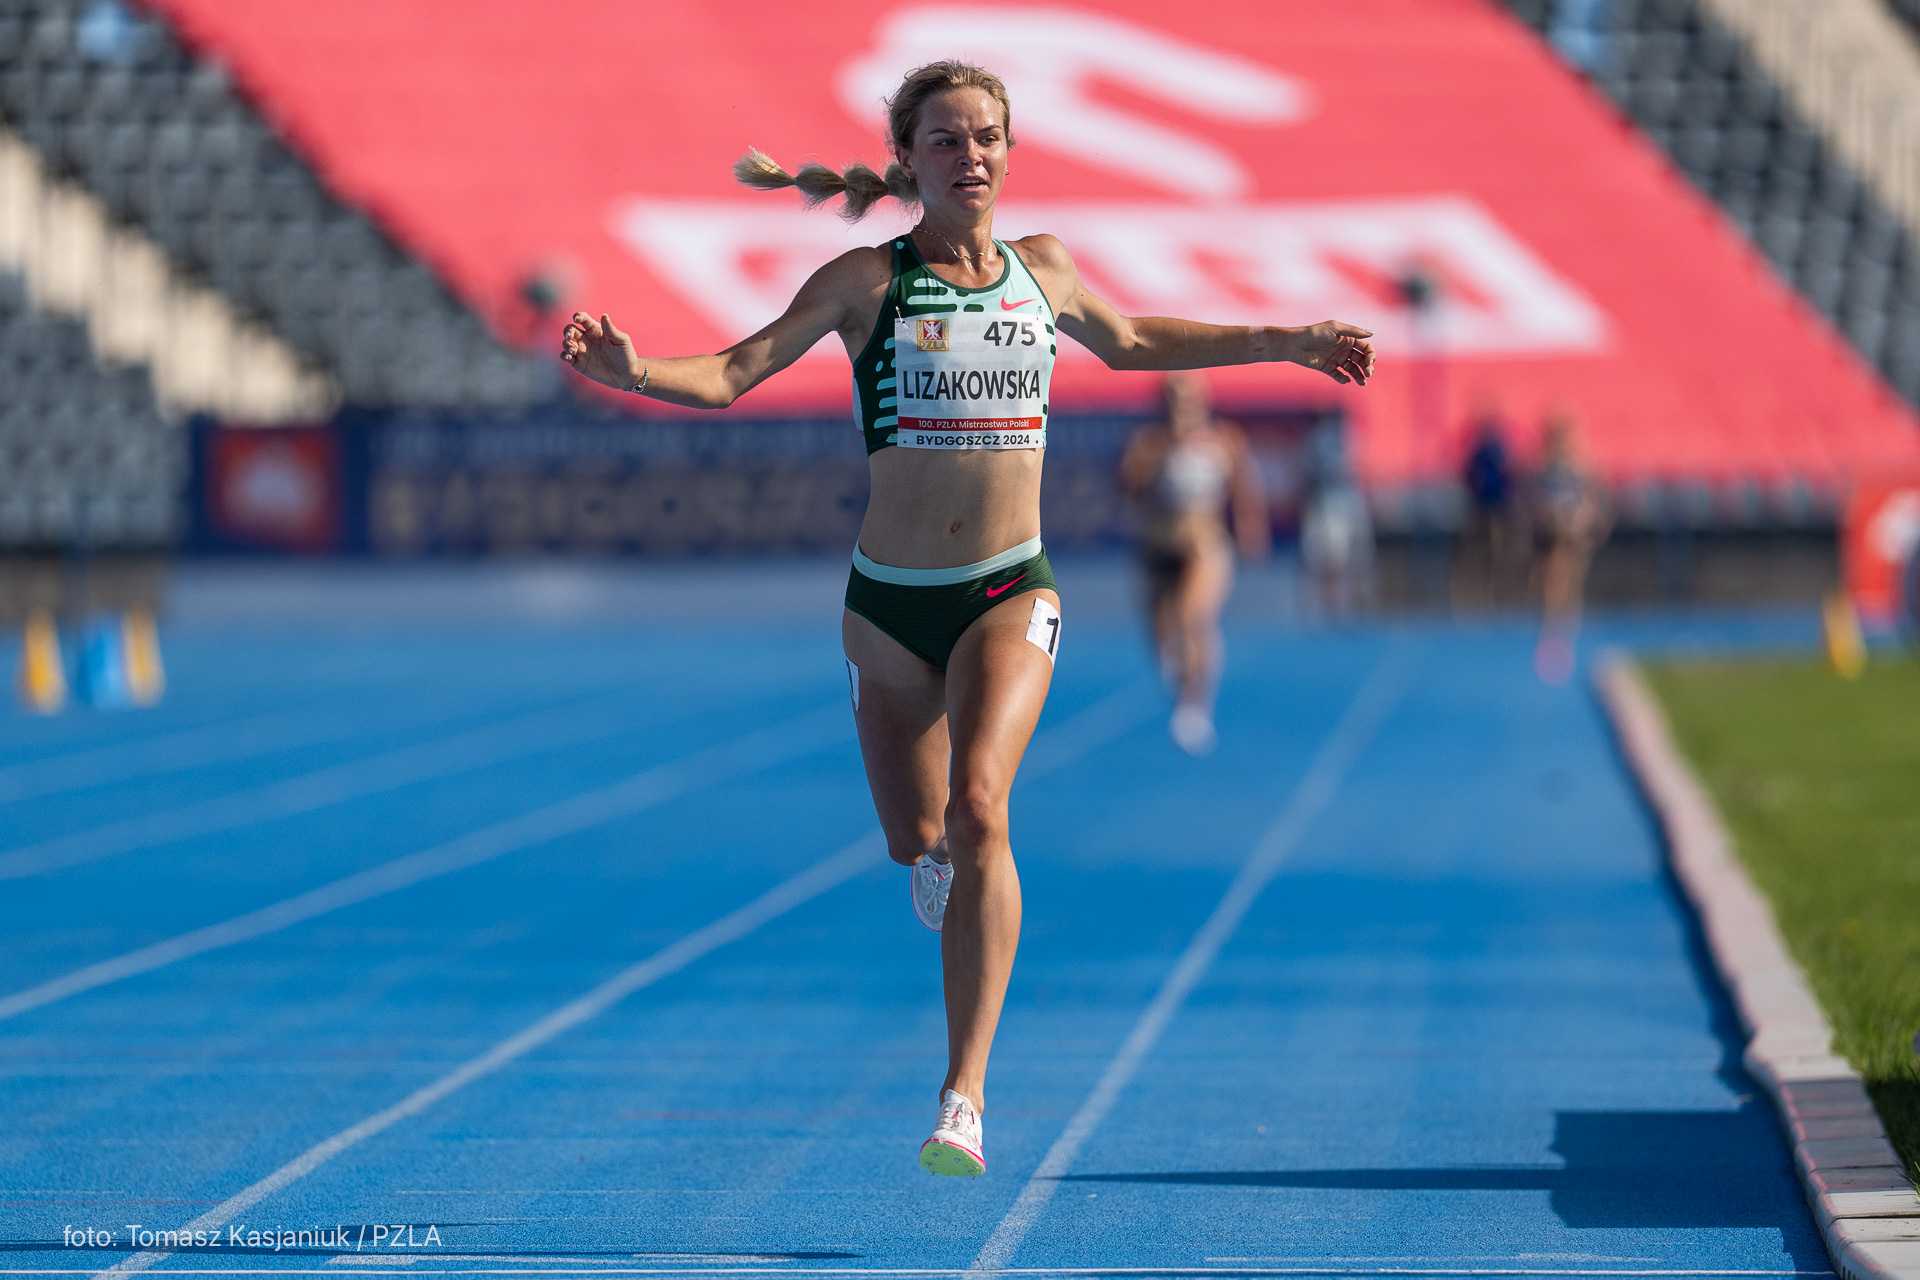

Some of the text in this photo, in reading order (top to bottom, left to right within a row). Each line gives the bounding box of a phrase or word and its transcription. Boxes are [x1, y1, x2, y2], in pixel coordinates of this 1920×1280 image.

[983, 321, 1036, 346] 475
[903, 369, 1041, 400] LIZAKOWSKA
[918, 418, 1030, 429] 100. PZLA Mistrzostwa Polski
[916, 434, 1030, 445] BYDGOSZCZ 2024
